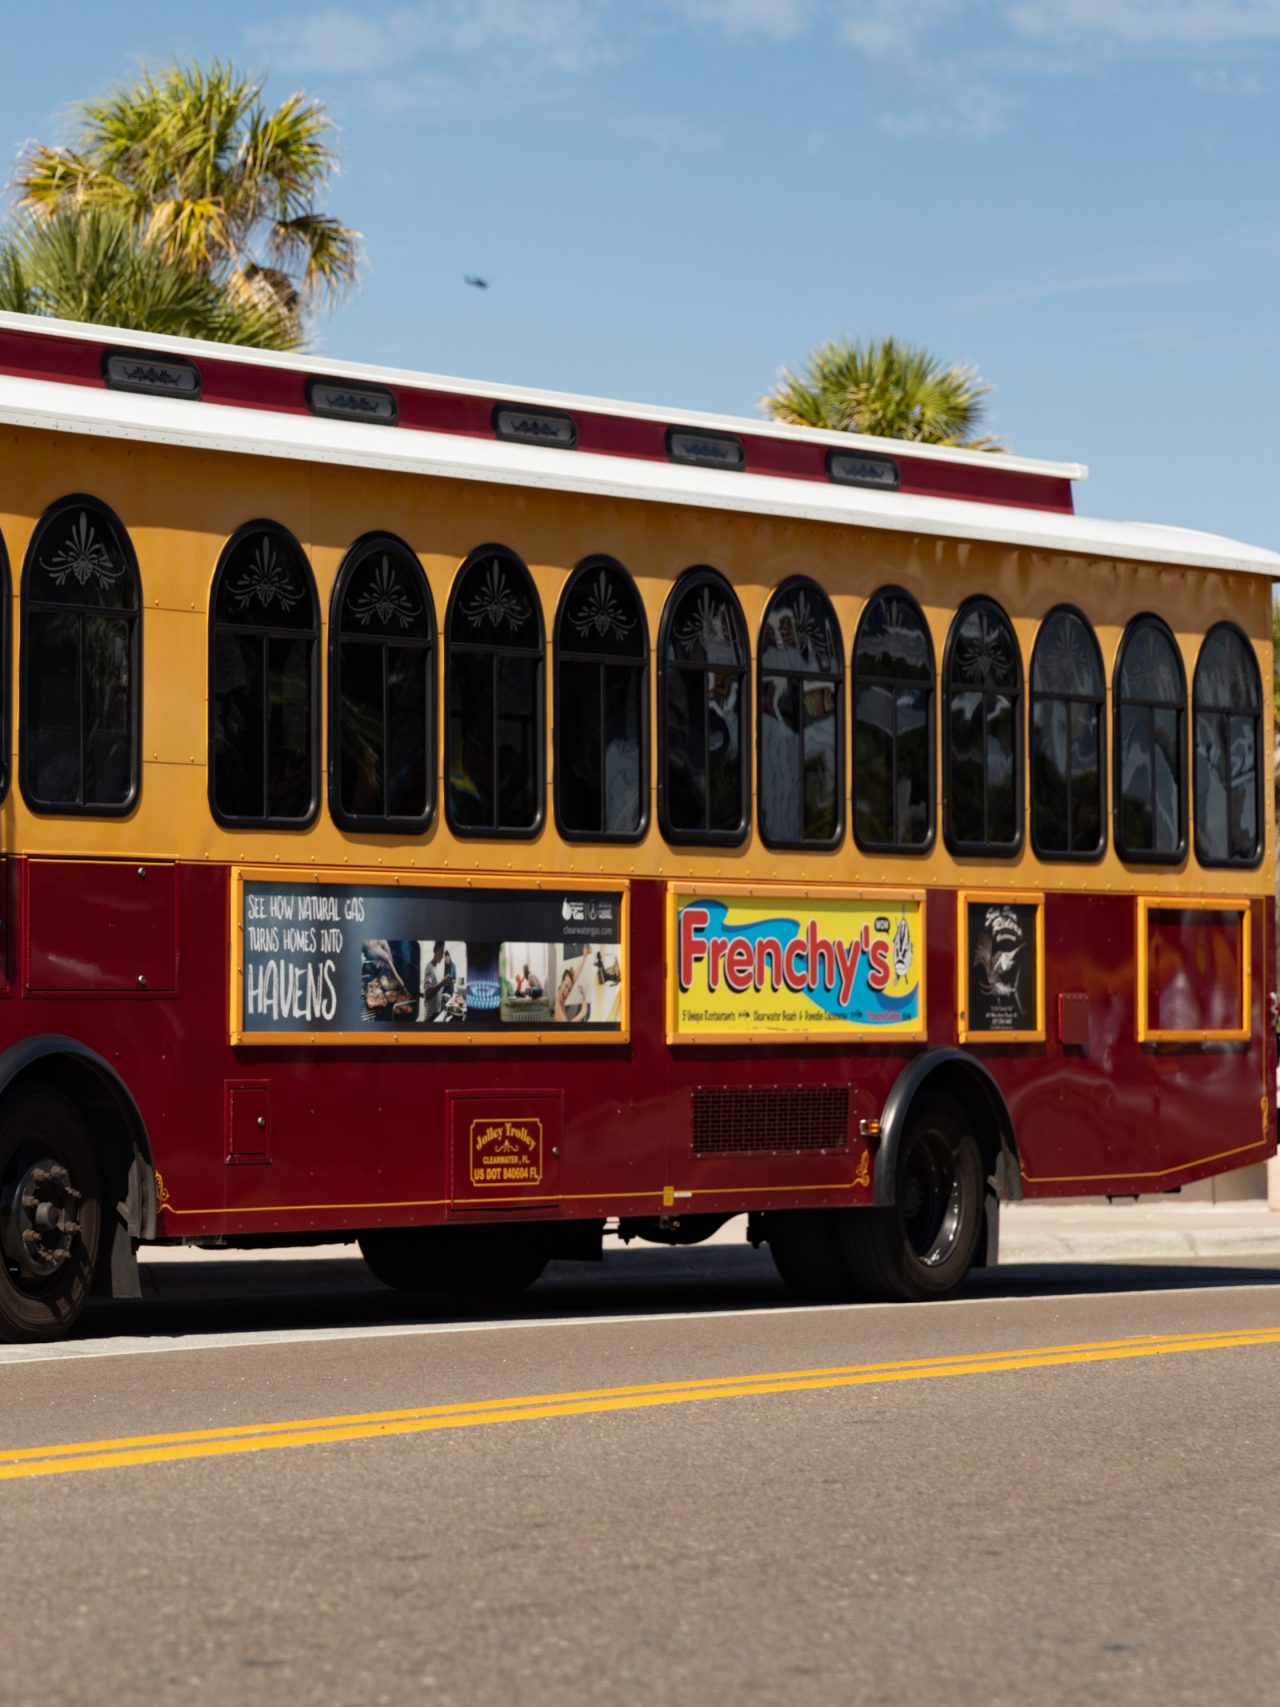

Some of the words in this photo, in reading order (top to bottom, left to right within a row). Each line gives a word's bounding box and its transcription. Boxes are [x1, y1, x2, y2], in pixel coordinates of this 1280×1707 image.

[248, 895, 267, 919] SEE
[270, 894, 294, 920] HOW
[298, 896, 341, 921] NATURAL
[344, 897, 365, 922] GAS
[248, 927, 279, 952] TURNS
[283, 927, 317, 953] HOMES
[321, 928, 343, 953] INTO
[563, 926, 613, 937] clearwatergas.com
[681, 908, 890, 1006] Frenchy's
[248, 960, 337, 1021] HAVENS
[476, 1127, 503, 1151] Jolley
[505, 1122, 536, 1151] Trolley
[474, 1168, 484, 1180] US
[486, 1168, 501, 1180] DOT
